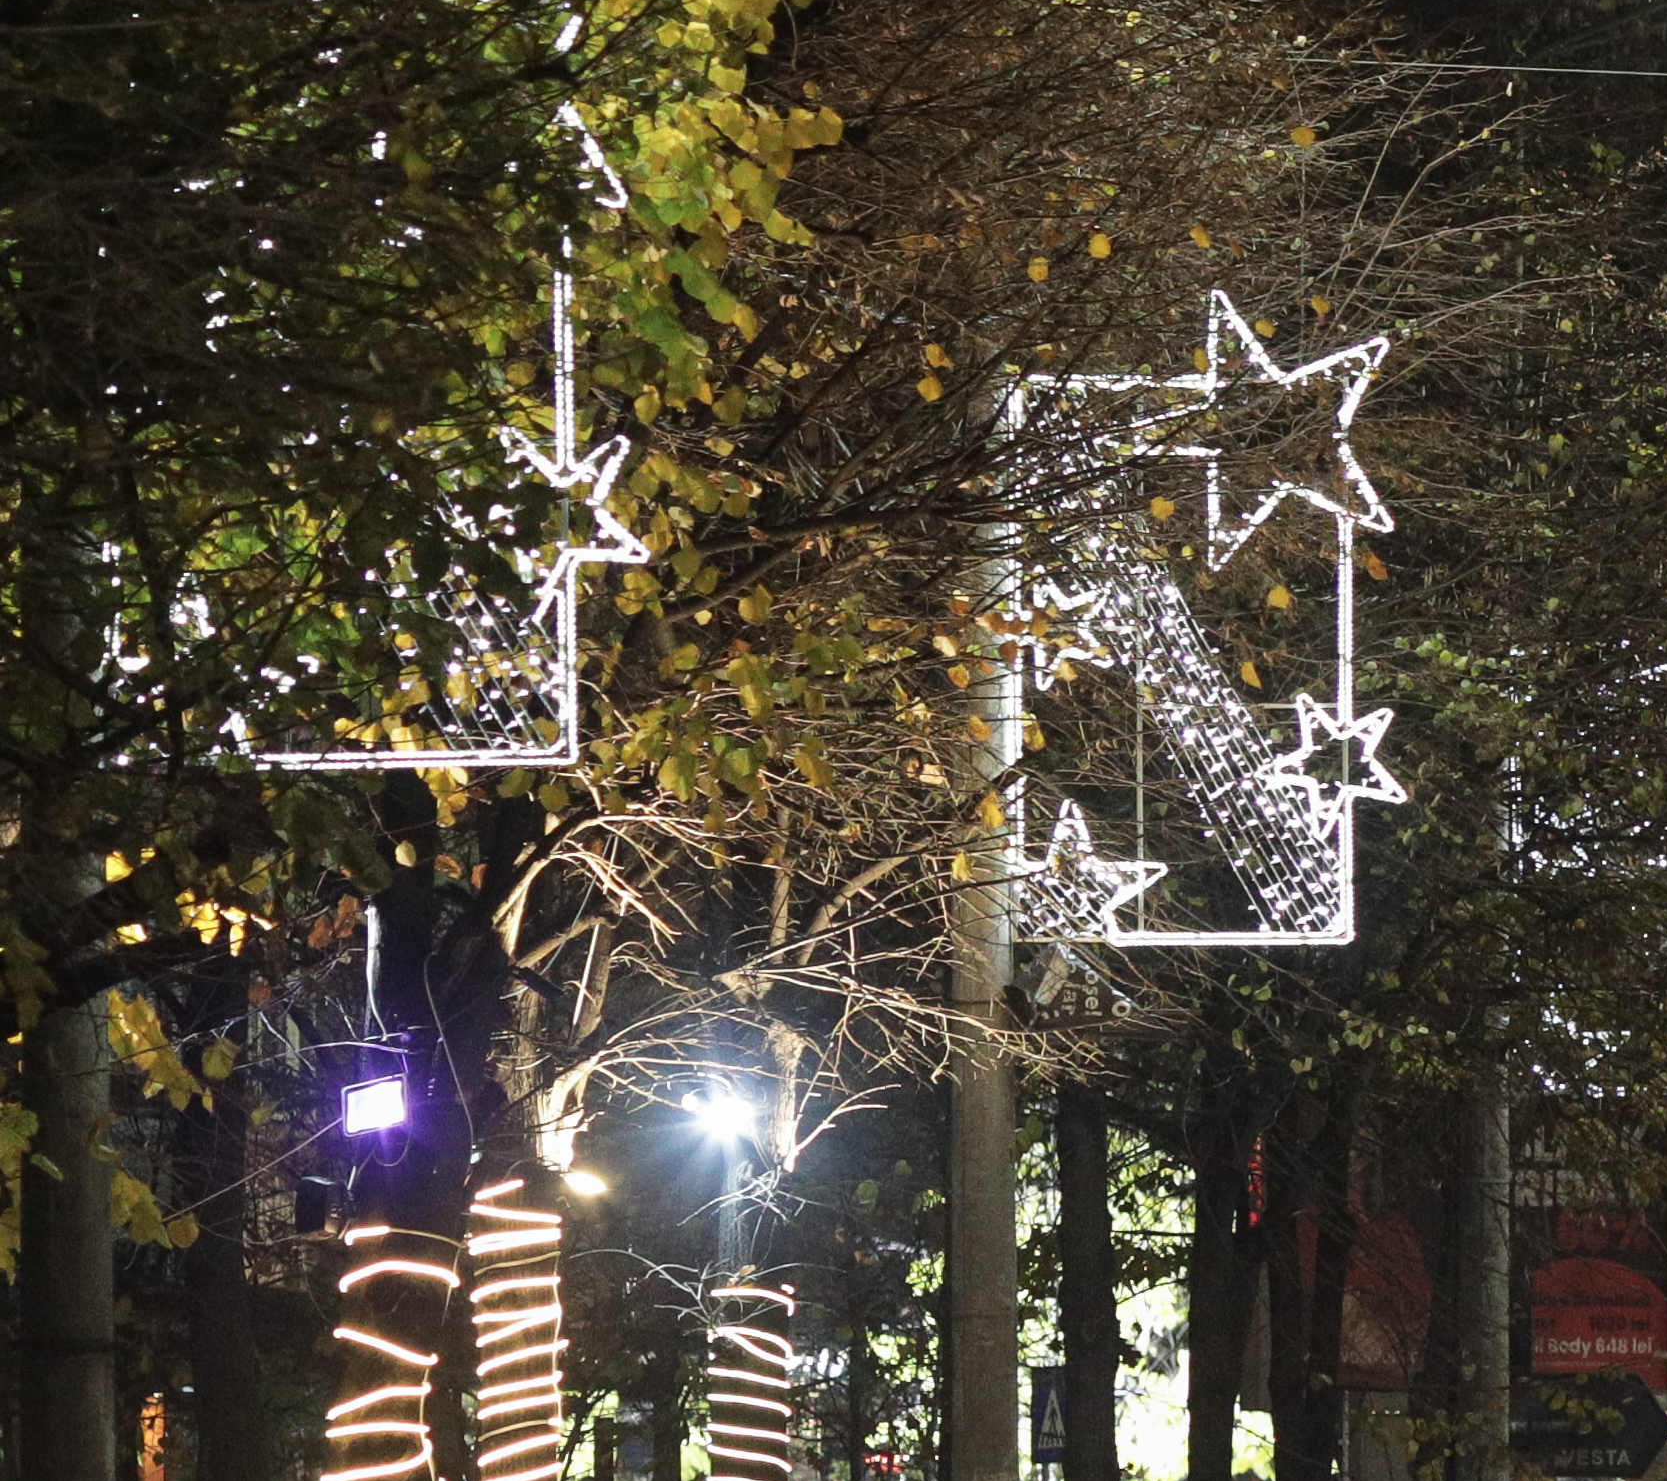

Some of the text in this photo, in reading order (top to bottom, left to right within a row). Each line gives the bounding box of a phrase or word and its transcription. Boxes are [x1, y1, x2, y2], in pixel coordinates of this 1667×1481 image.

[1547, 1336, 1592, 1358] Body
[1595, 1336, 1629, 1355] 648
[1631, 1336, 1653, 1355] lei
